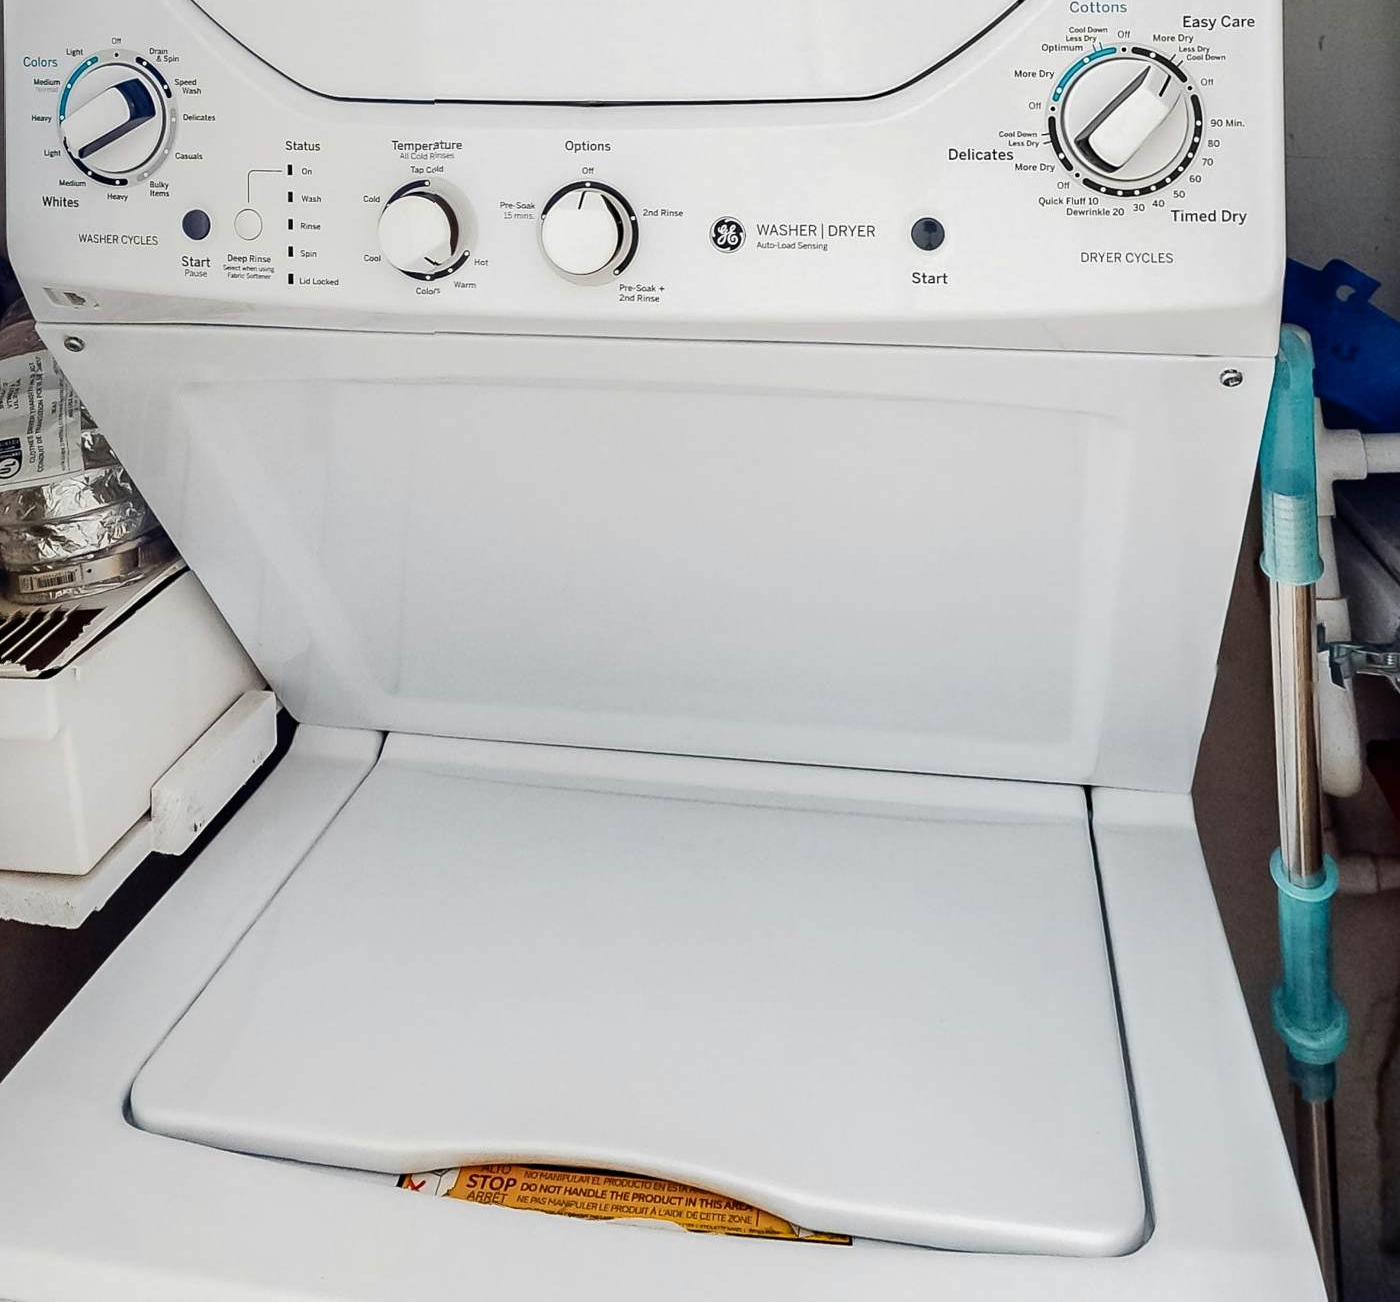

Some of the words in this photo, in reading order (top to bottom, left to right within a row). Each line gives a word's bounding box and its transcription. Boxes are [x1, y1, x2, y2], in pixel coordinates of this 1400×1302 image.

[1070, 1, 1127, 13] Cottons
[1183, 16, 1217, 30] Easy
[1221, 16, 1255, 27] Care
[1118, 30, 1130, 38] Off
[1153, 34, 1173, 42] More
[1174, 34, 1194, 43] Dry
[1084, 35, 1097, 43] Dry
[66, 48, 83, 57] Light
[149, 48, 168, 56] Drain
[1042, 44, 1083, 53] Optimum
[1197, 45, 1210, 55] Dry
[23, 57, 58, 67] Colors
[164, 55, 179, 63] Spin
[1039, 70, 1054, 79] Dry
[174, 77, 197, 87] Speed
[1201, 78, 1213, 86] Off
[1029, 102, 1041, 110] Off
[32, 115, 52, 123] Heavy
[1210, 119, 1223, 127] 90
[1226, 119, 1245, 127] Min.
[285, 141, 320, 151] Status
[392, 140, 462, 152] Temperature
[565, 141, 611, 153] Options
[1026, 140, 1039, 148] Dry
[44, 150, 61, 158] Light
[175, 152, 203, 160] Casuals
[411, 152, 428, 160] Cold
[430, 152, 454, 160] Rinses
[949, 148, 1014, 160] Delicates
[1202, 158, 1213, 166] 70
[410, 166, 424, 174] Tap
[426, 165, 443, 173] Cold
[1015, 163, 1036, 171] More
[1040, 163, 1055, 173] Dry
[1189, 175, 1201, 183] 60
[150, 181, 169, 190] Bulky
[1057, 181, 1070, 189] Off
[107, 193, 128, 202] Heavy
[150, 189, 169, 197] Items
[1174, 190, 1185, 198] 50
[42, 196, 79, 207] Whites
[363, 195, 380, 203] Cold
[1039, 197, 1063, 207] Quick
[1066, 197, 1086, 205] Fluff
[1089, 197, 1099, 205] 10
[1152, 199, 1165, 207] 40
[504, 211, 512, 219] 15
[658, 209, 683, 217] Rinse
[1067, 208, 1110, 216] Dewrinkle
[1113, 208, 1124, 216] 20
[1171, 210, 1216, 222] Timed
[1222, 210, 1247, 225] Dry
[757, 224, 817, 236] WASHER
[829, 225, 875, 237] DRYER
[79, 234, 119, 244] WASHER
[121, 235, 158, 246] CYCLES
[798, 242, 828, 251] Sensing
[300, 250, 317, 258] Spin
[1081, 252, 1121, 263] DRYER
[1126, 252, 1173, 263] CYCLES
[182, 256, 211, 268] Start
[228, 254, 247, 264] Deep
[249, 255, 271, 263] Rinse
[185, 269, 207, 277] Pause
[299, 277, 310, 285] Lid
[912, 272, 948, 284] Start
[416, 287, 440, 295] Colors
[619, 284, 656, 292] Pre-Soak
[637, 294, 659, 302] Rinse
[467, 1174, 517, 1191] STOP
[524, 1171, 538, 1180] NO
[604, 1177, 651, 1190] PRODUCTO
[520, 1182, 537, 1192] DO
[539, 1184, 562, 1194] NOT
[564, 1187, 607, 1199] HANDLE
[610, 1190, 630, 1201] THE
[631, 1192, 683, 1206] PRODUCT
[685, 1197, 697, 1207] IN
[699, 1198, 722, 1209] THIS
[516, 1195, 529, 1204] NE
[530, 1196, 546, 1205] PAS
[550, 1198, 598, 1210] MANIPULER
[599, 1202, 610, 1211] LE
[610, 1205, 648, 1215] PRODUIT
[686, 1210, 698, 1220] DE
[700, 1212, 726, 1222] CETTE
[728, 1214, 753, 1225] ZONE
